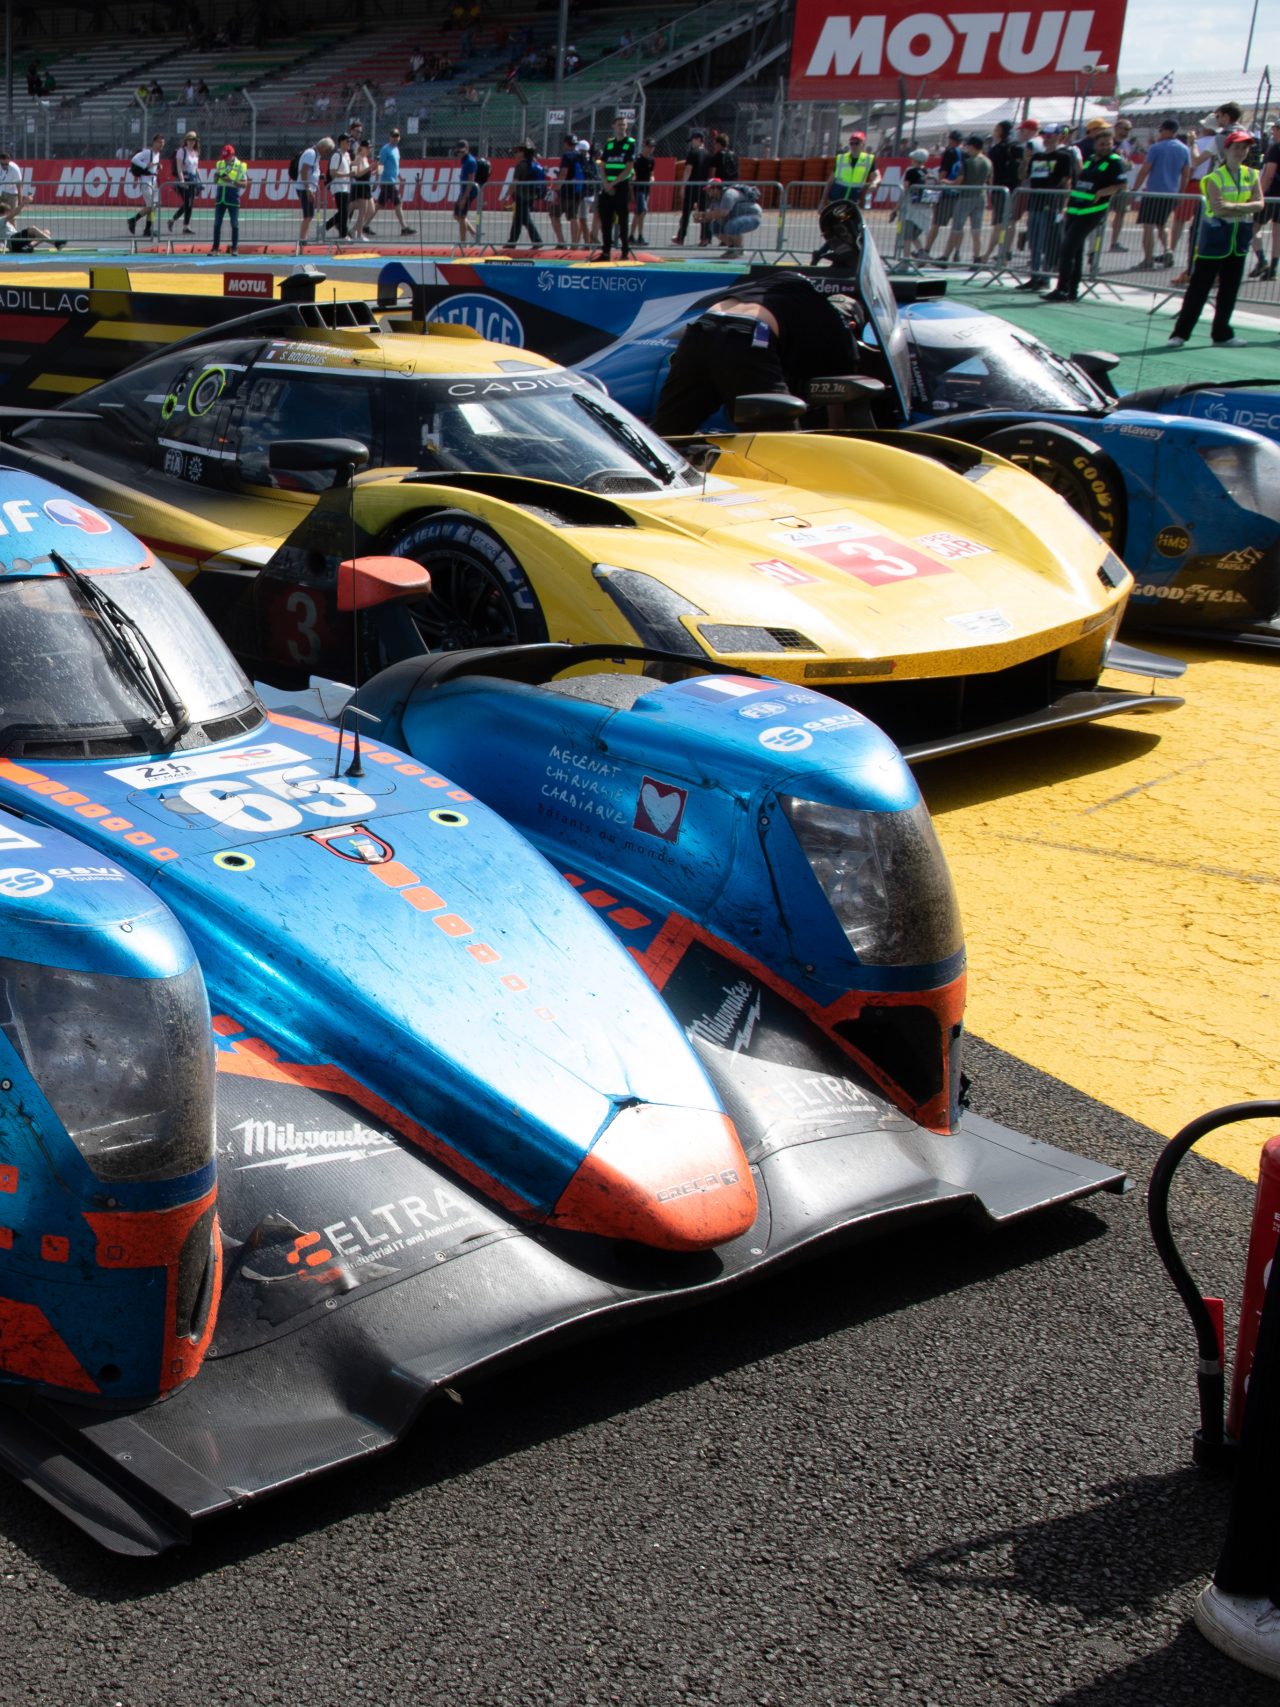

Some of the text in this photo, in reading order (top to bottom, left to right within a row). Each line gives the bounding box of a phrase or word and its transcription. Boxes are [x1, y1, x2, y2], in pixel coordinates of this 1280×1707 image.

[805, 9, 1104, 77] MOTUL
[55, 166, 144, 199] MOTU
[228, 278, 267, 293] MOTUL
[448, 377, 583, 396] CADILL
[837, 542, 918, 577] 3
[286, 591, 320, 667] 3
[179, 765, 376, 832] 65
[230, 1118, 399, 1157] Milwaukee
[323, 1187, 468, 1258] ELTRA
